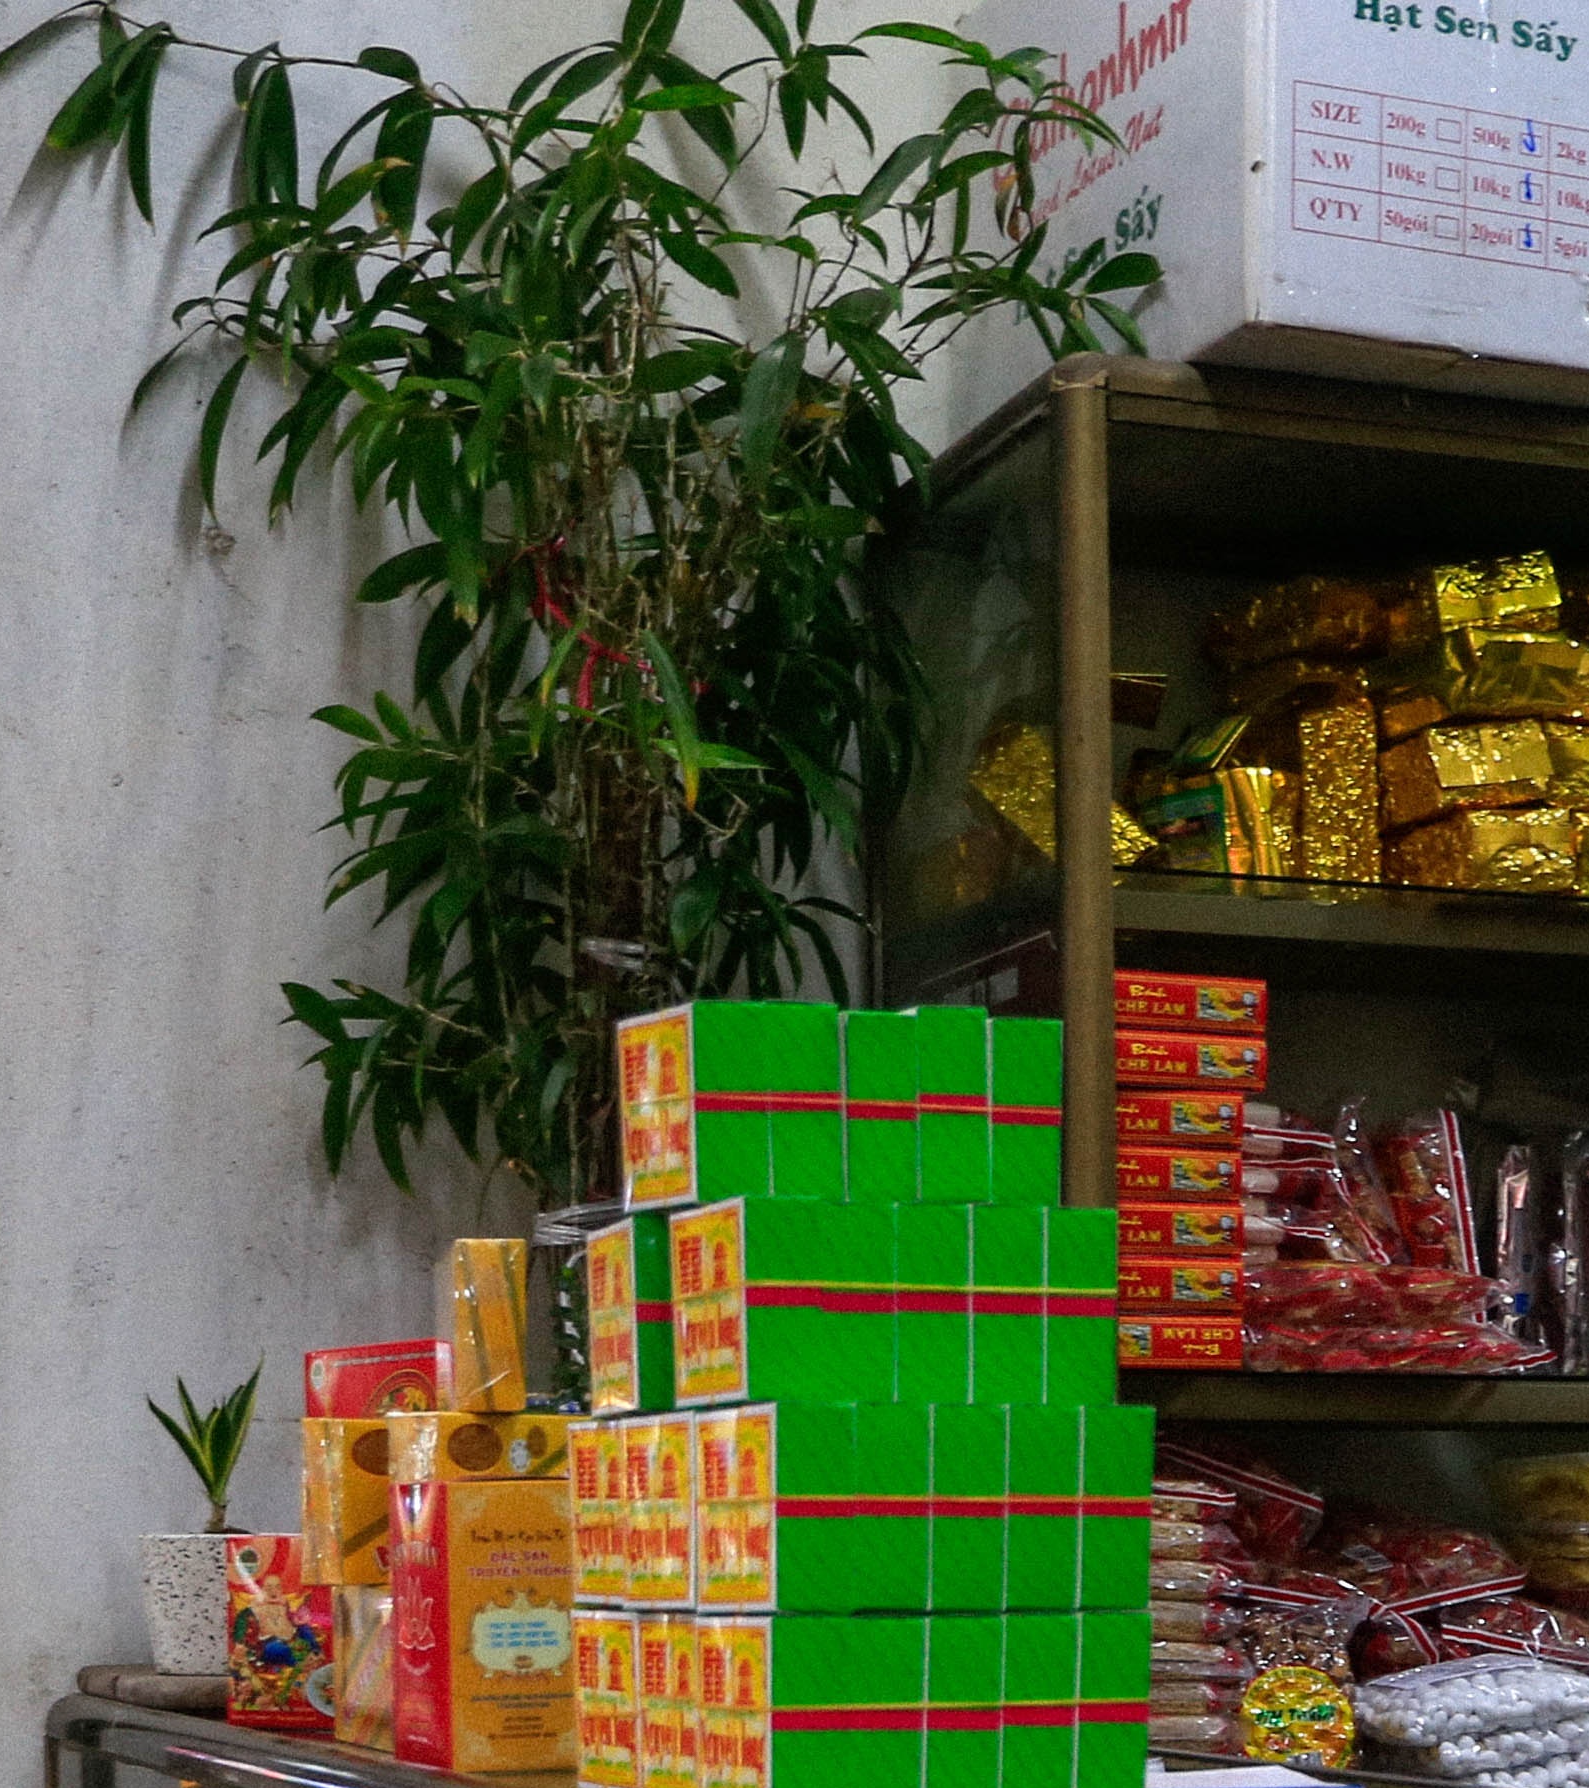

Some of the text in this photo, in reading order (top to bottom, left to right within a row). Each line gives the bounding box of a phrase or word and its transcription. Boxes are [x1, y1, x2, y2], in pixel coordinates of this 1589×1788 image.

[1434, 5, 1500, 44] Sen
[1512, 19, 1578, 61] Sấy
[1310, 99, 1587, 166] SIZE 200g 500g 2kg
[1310, 149, 1353, 171] N.W
[1386, 161, 1427, 185] 10kg
[1473, 176, 1511, 199] 10kg
[1114, 185, 1163, 251] Sấy
[1310, 197, 1363, 222] Q'TY
[1384, 210, 1428, 233] 50gói
[1152, 1003, 1186, 1015] LAM
[1154, 1061, 1187, 1073] LAM
[1125, 1119, 1159, 1130] LAM
[1126, 1175, 1160, 1187] LAM
[1128, 1230, 1162, 1242] LAM
[1128, 1286, 1161, 1298] LAM
